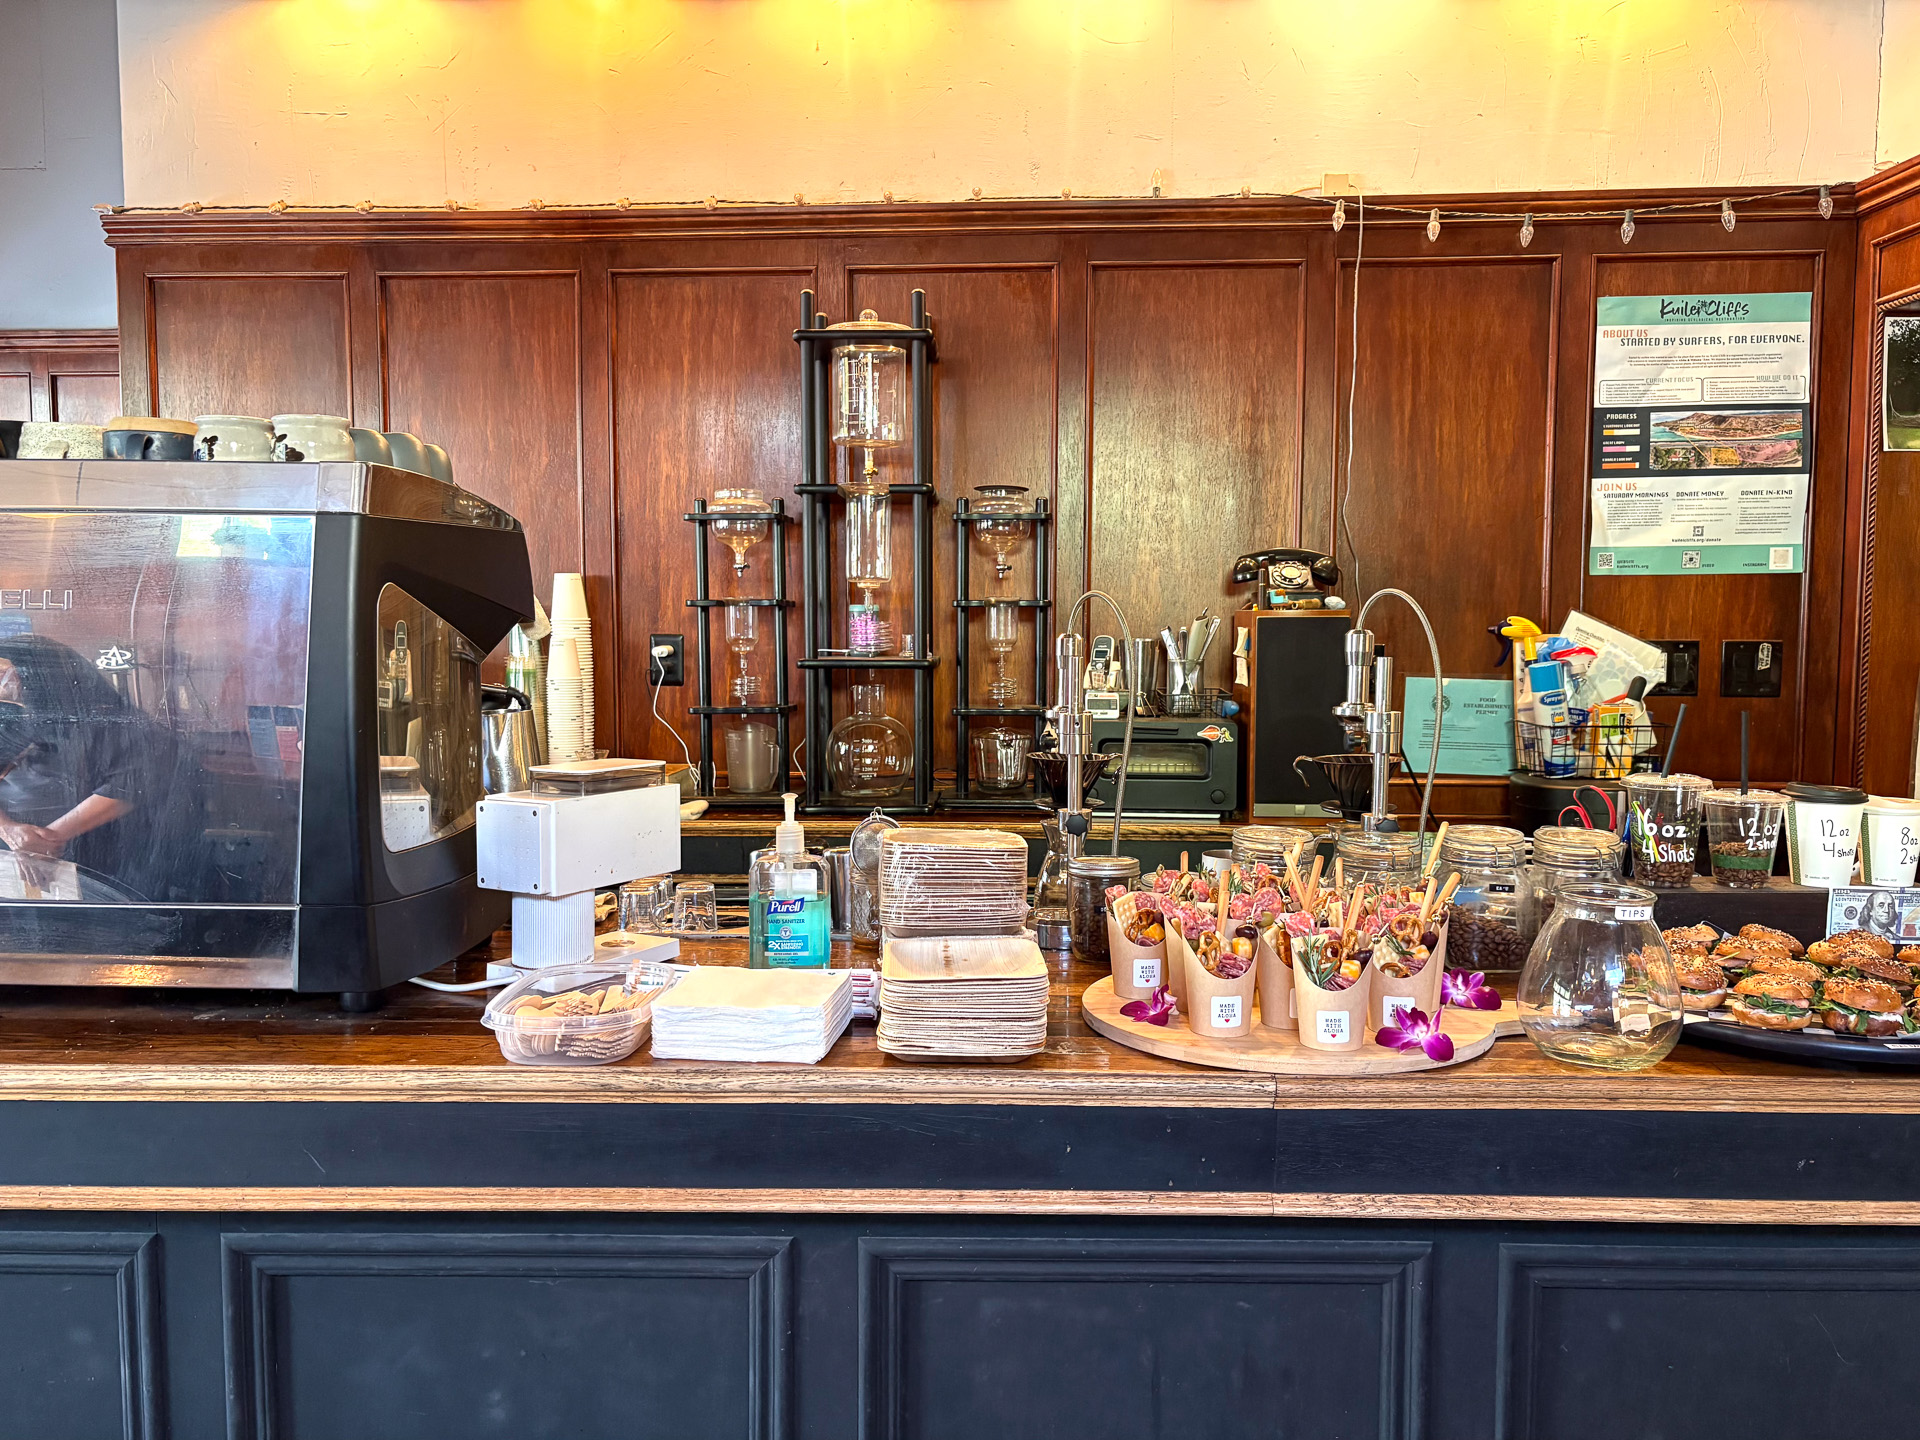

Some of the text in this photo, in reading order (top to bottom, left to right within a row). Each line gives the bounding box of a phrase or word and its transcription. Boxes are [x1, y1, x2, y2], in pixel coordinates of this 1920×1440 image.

[1706, 300, 1749, 317] Cliffs
[1603, 329, 1649, 338] ABOUT US
[1621, 334, 1805, 346] STARTED BY SURFERS, FOR EVERYONE.
[1597, 482, 1637, 491] JOIN US
[1637, 808, 1657, 836] 16
[1739, 818, 1760, 837] 12
[1821, 819, 1850, 837] 12 oz
[1901, 827, 1911, 845] 8
[1642, 839, 1695, 863] 4 Shots
[1745, 839, 1757, 851] 2
[1823, 842, 1836, 858] 4
[1900, 848, 1909, 864] 2
[771, 900, 802, 913] Purell
[1621, 909, 1645, 918] TIPS
